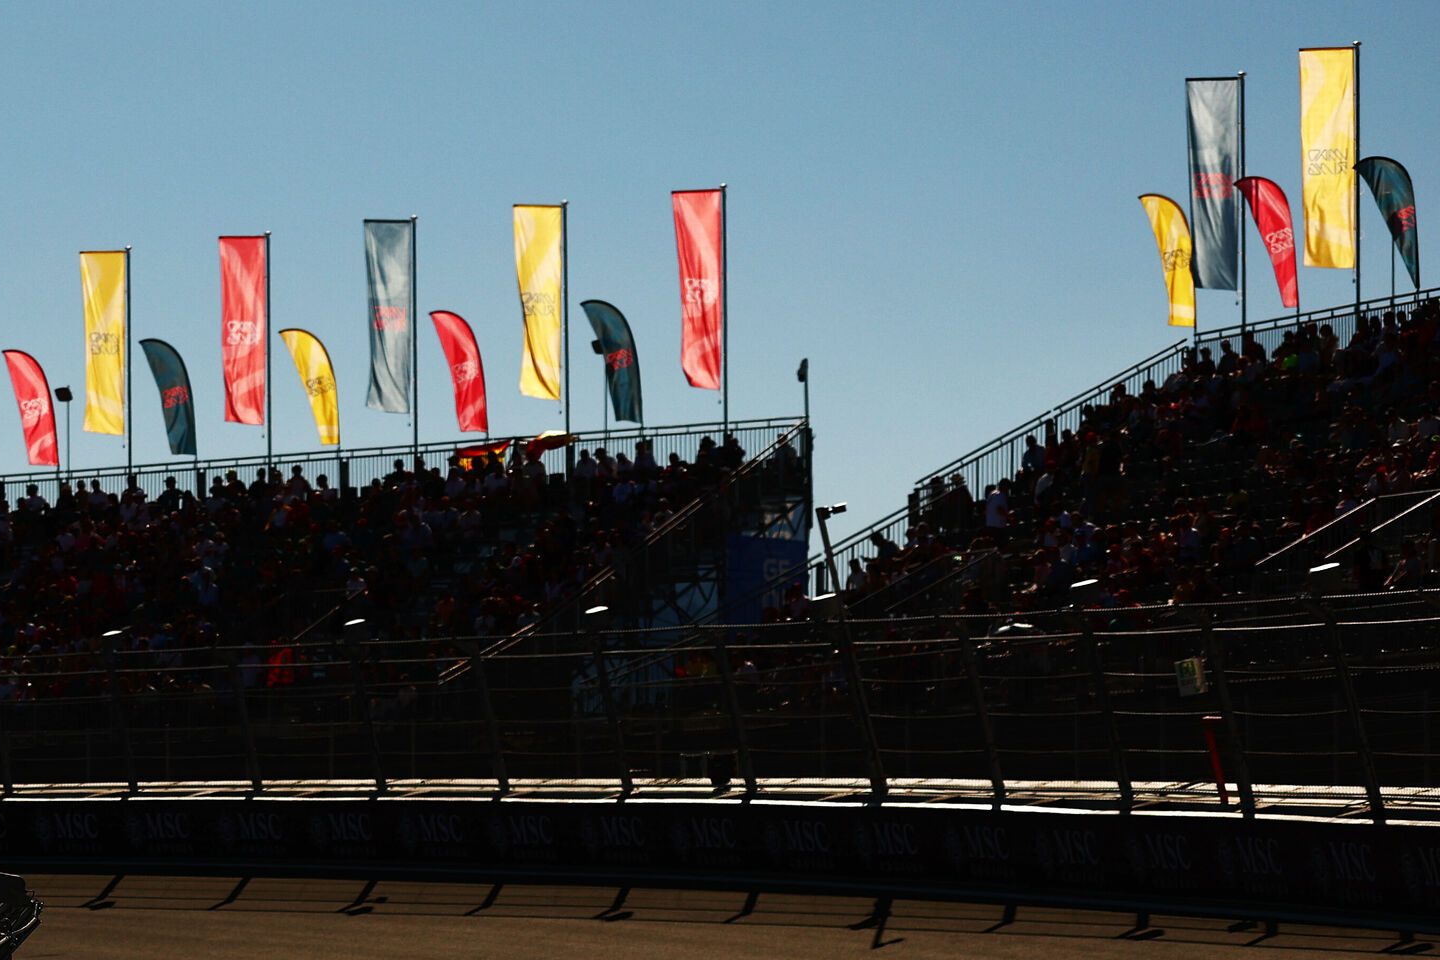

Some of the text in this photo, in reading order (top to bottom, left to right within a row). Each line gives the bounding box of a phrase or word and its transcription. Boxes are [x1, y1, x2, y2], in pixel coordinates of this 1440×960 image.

[54, 813, 100, 840] MSC
[143, 813, 191, 841] MSC
[237, 813, 283, 841] MSC
[328, 813, 373, 841] MSC
[416, 814, 464, 843] MSC
[508, 815, 555, 846] MSC
[600, 816, 646, 847] MSC
[690, 817, 738, 848] MSC
[783, 819, 832, 852] MSC
[871, 823, 920, 856] MSC
[963, 824, 1010, 860] MSC
[1053, 829, 1100, 865] MSC
